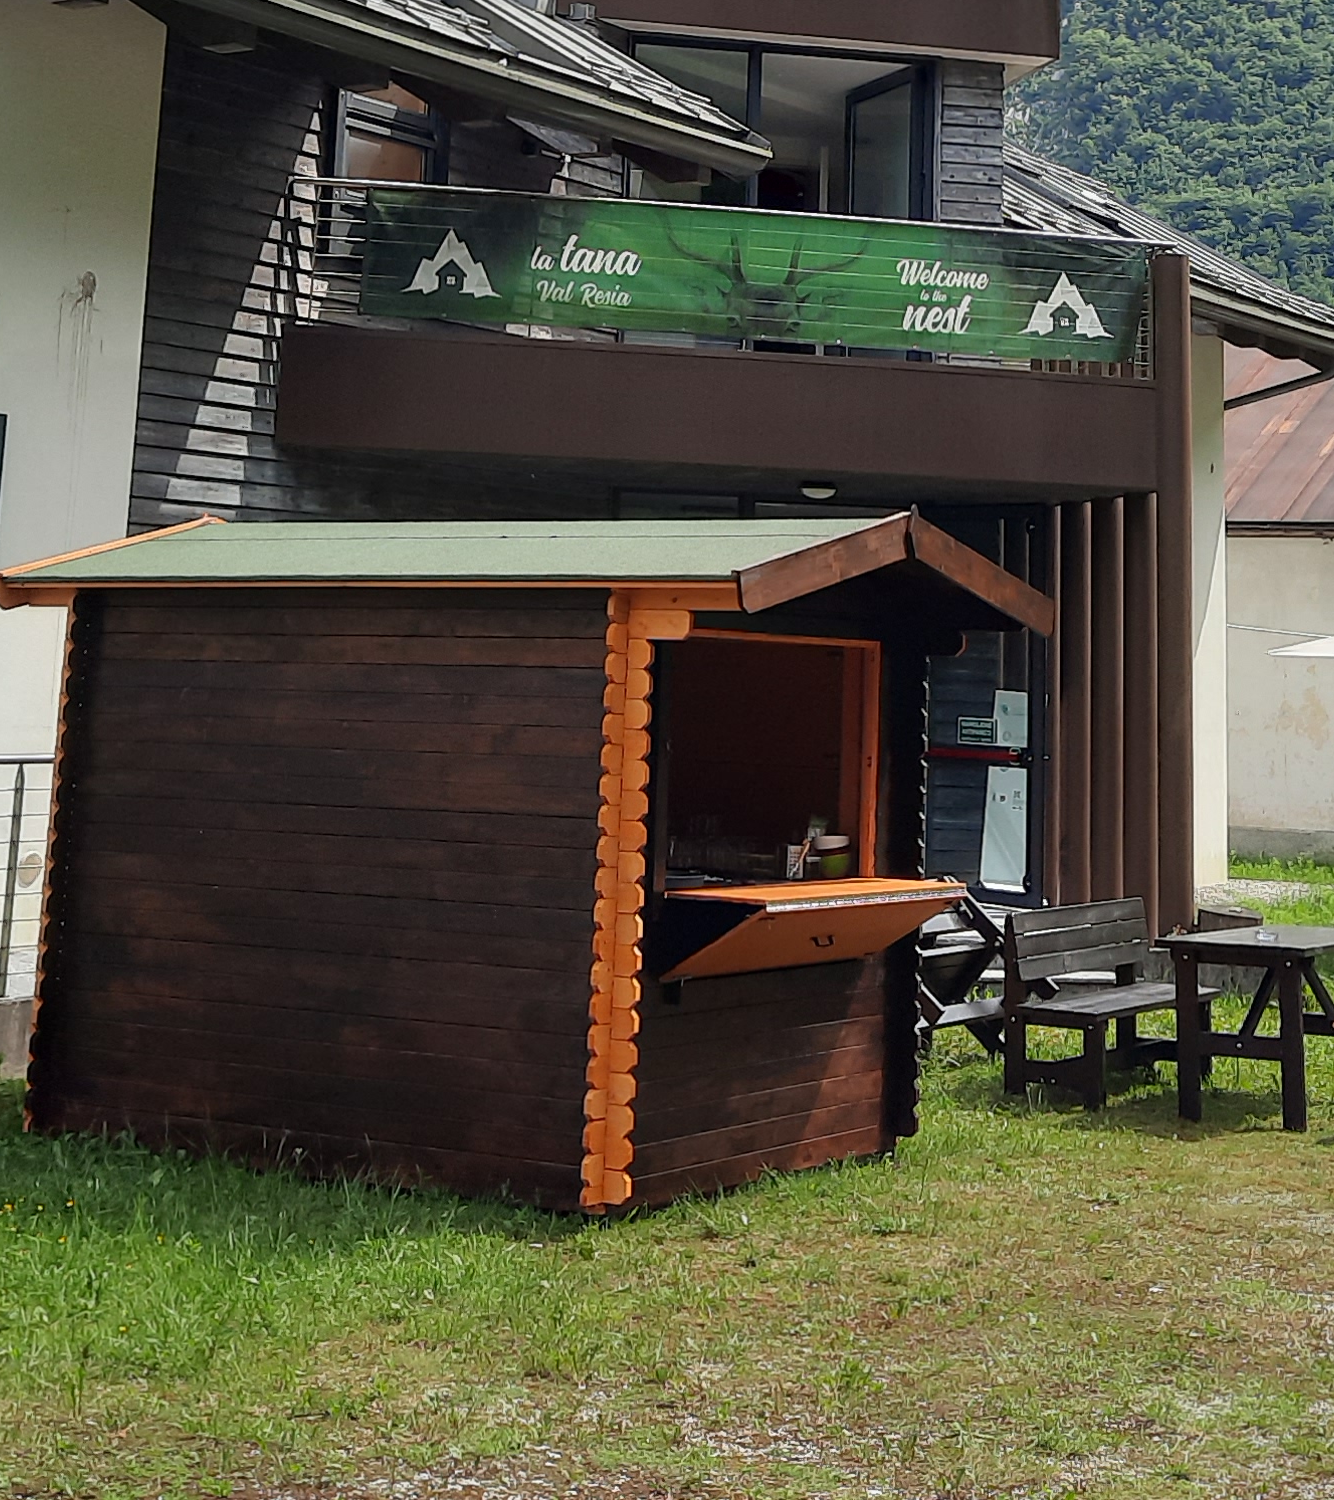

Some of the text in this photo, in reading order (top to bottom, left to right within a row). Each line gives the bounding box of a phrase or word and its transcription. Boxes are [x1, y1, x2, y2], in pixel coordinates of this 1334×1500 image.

[530, 234, 642, 276] la tana
[896, 259, 989, 290] Welcome
[536, 280, 633, 308] Val Resia
[902, 294, 973, 334] nest
